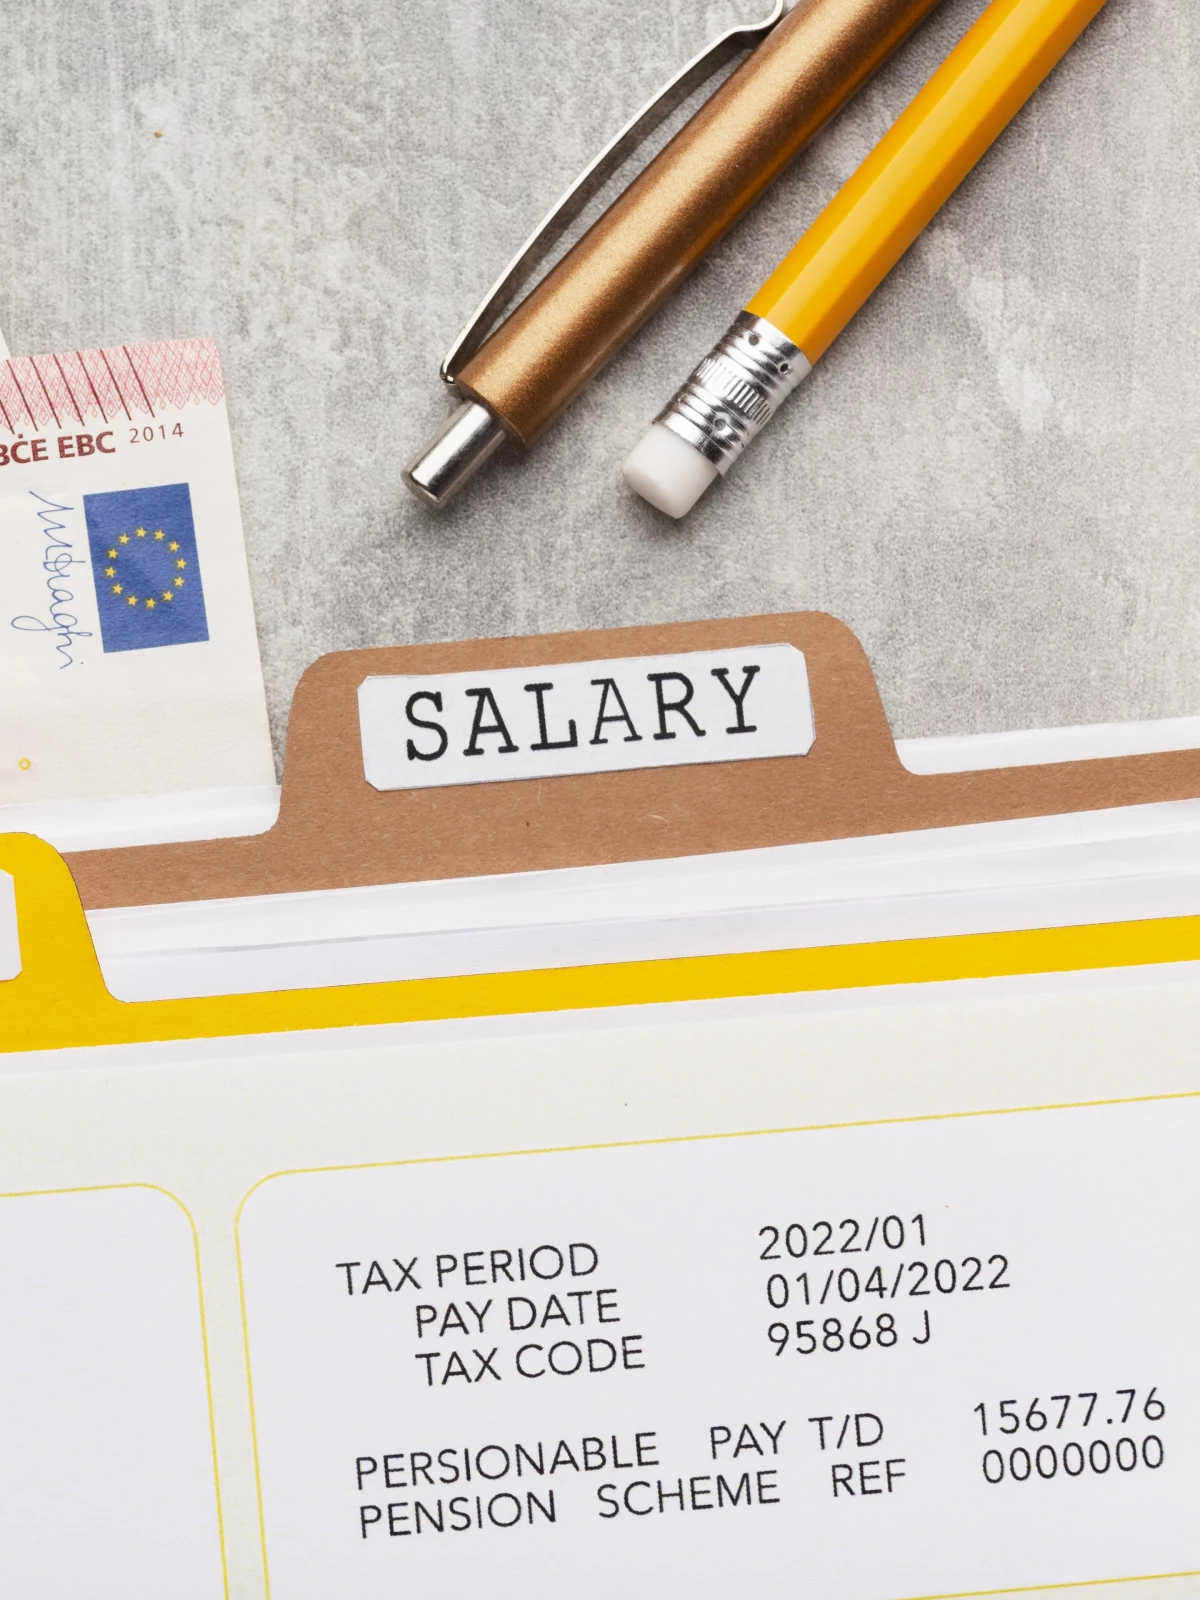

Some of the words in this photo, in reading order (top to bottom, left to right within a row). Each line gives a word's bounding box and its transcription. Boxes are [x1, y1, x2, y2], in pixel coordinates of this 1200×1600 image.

[57, 431, 116, 459] EBC
[128, 422, 185, 445] 2014
[404, 665, 761, 761] SALARY
[336, 1258, 421, 1295] TAX
[436, 1243, 598, 1288] PERIOD
[759, 1213, 926, 1259] 2022/01
[416, 1300, 492, 1338] PAY
[508, 1289, 621, 1330] DATE
[767, 1255, 1010, 1308] 01/04/2022
[415, 1348, 501, 1386] TAX
[516, 1335, 645, 1378] CODE
[768, 1313, 898, 1357] 95868
[913, 1310, 931, 1344] J
[356, 1432, 659, 1490] PERSIONABLE
[710, 1421, 786, 1459] PAY
[808, 1413, 883, 1450] T/D
[974, 1387, 1165, 1436] 15677.76
[360, 1490, 555, 1539] PENSION
[597, 1470, 781, 1518] SCHEME
[832, 1459, 906, 1497] REF
[983, 1435, 1163, 1484] 0000000
